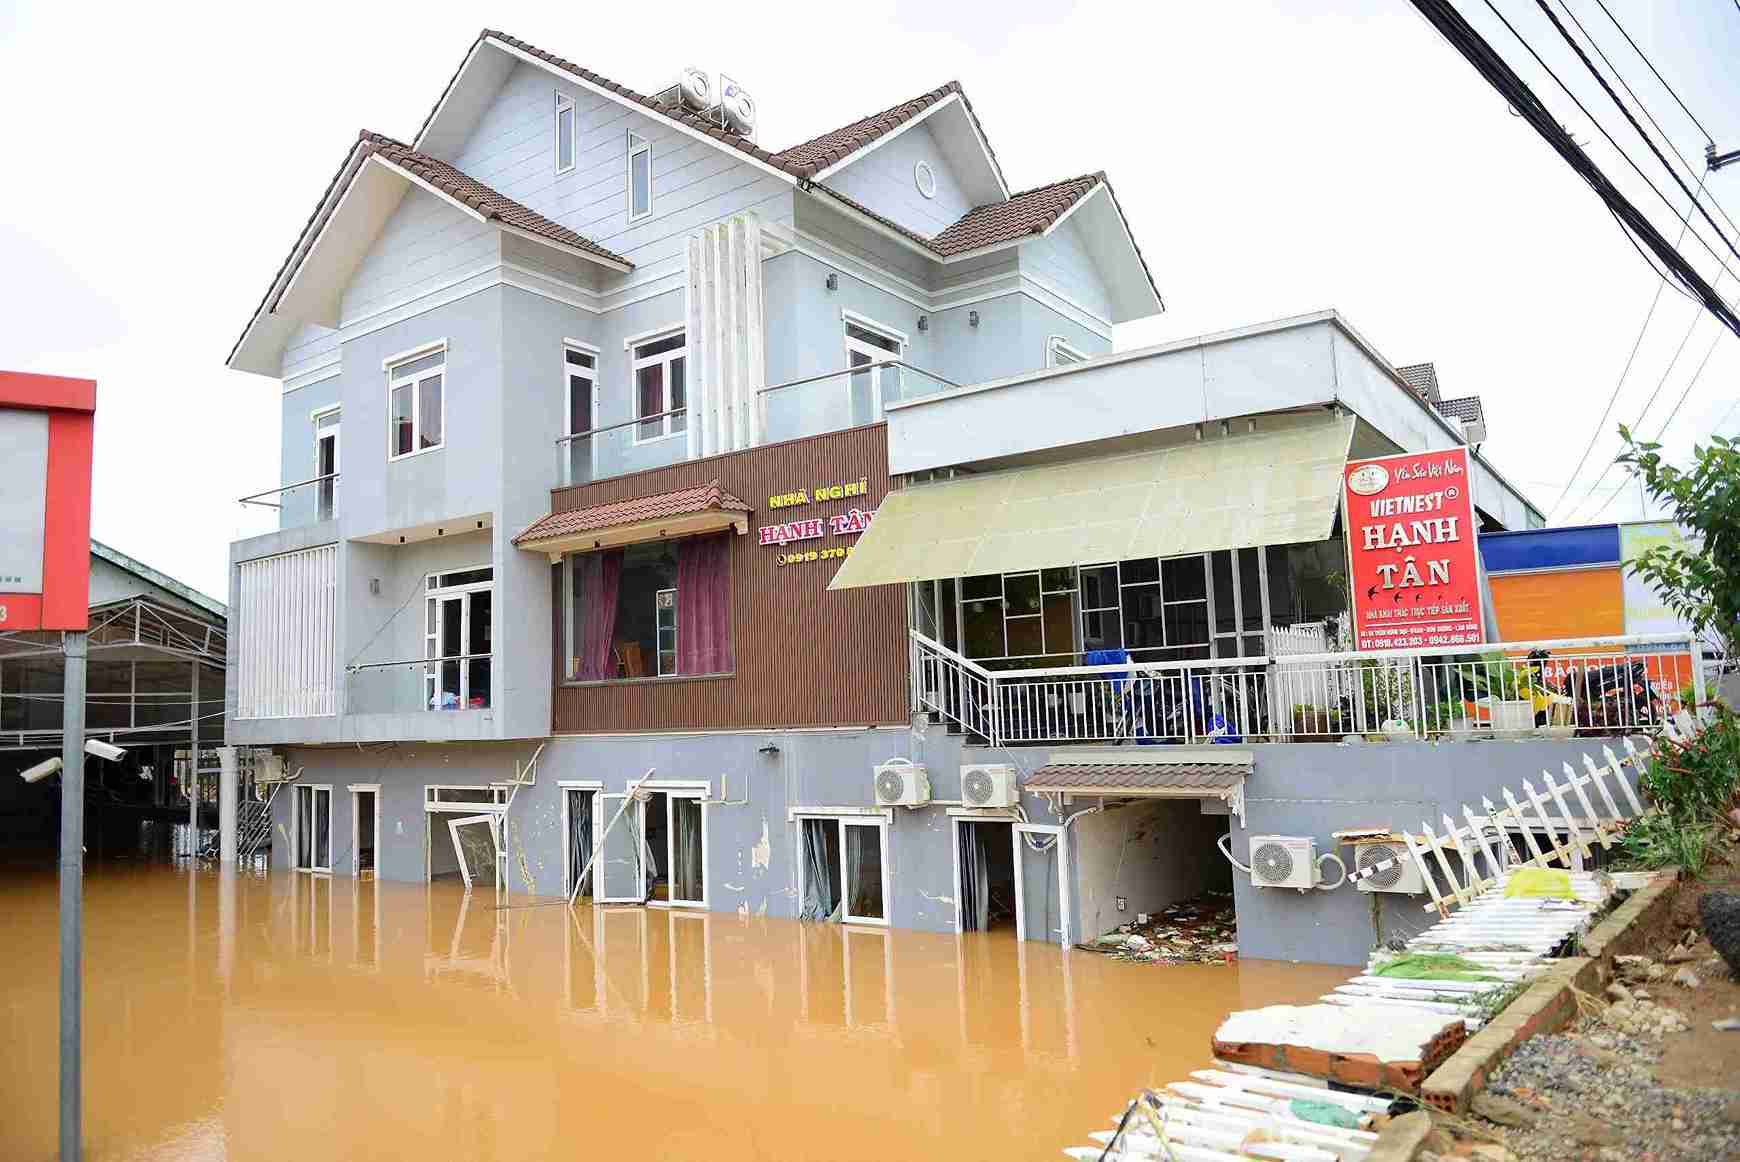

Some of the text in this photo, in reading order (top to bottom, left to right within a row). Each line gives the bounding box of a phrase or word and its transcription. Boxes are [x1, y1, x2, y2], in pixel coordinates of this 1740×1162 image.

[769, 489, 809, 509] NHÀ
[1369, 491, 1444, 517] VIETNEST
[760, 518, 823, 546] HẠNH
[1361, 516, 1460, 552] HẠNH
[1376, 556, 1451, 589] TÂN
